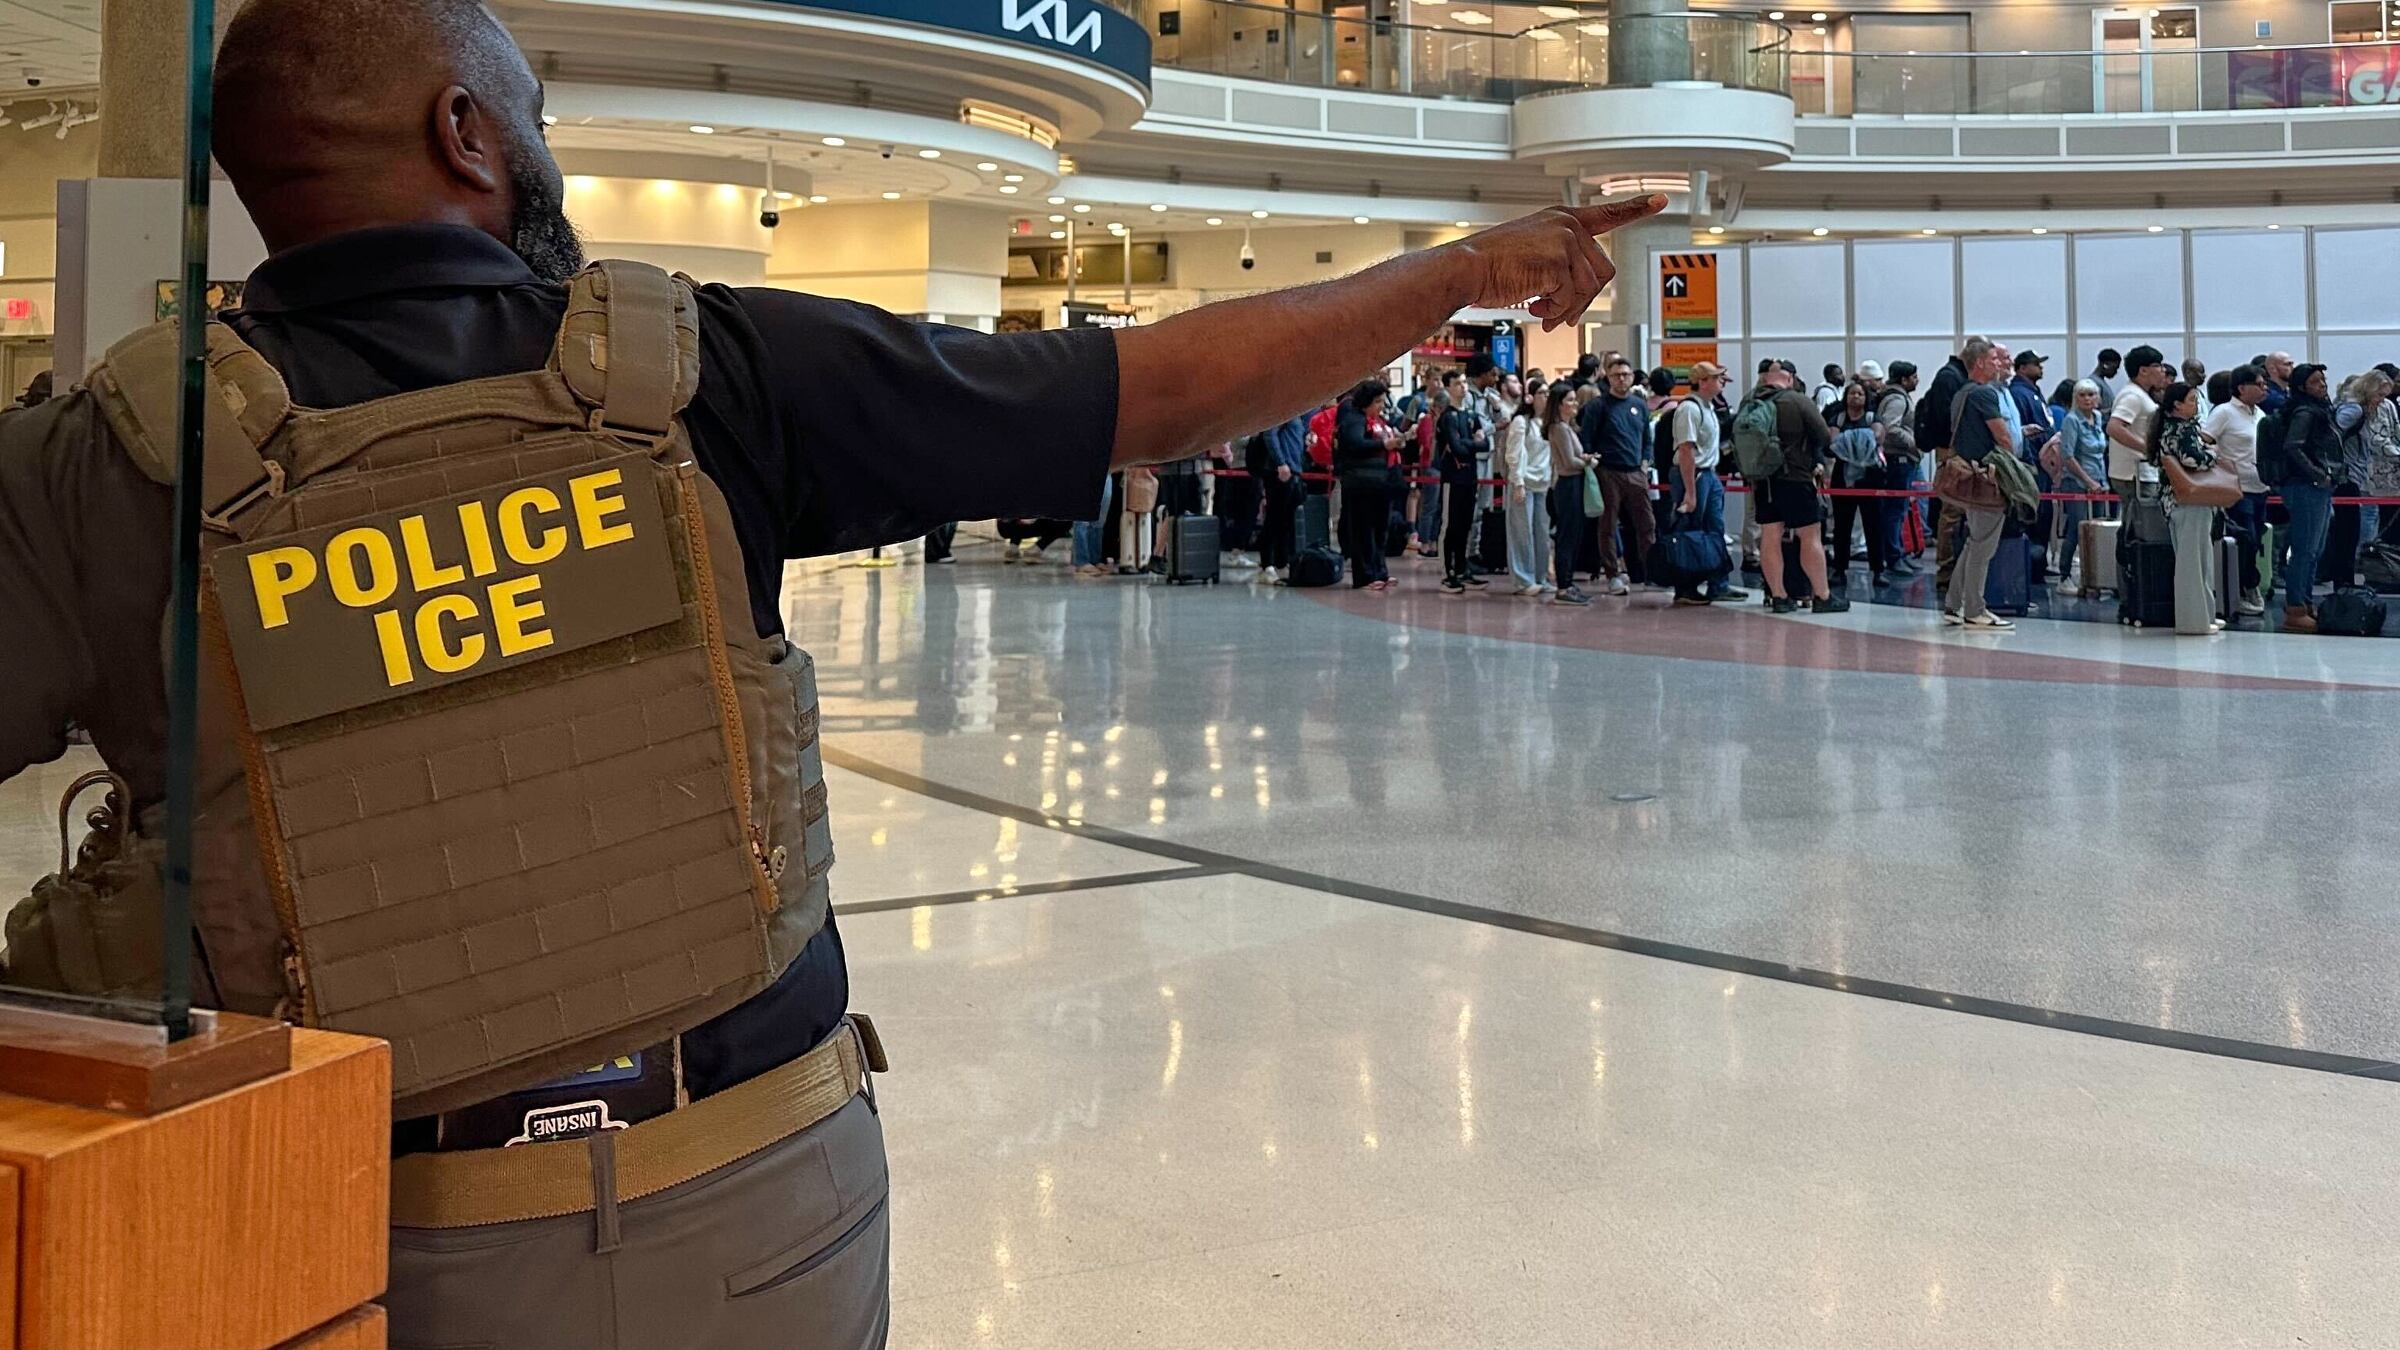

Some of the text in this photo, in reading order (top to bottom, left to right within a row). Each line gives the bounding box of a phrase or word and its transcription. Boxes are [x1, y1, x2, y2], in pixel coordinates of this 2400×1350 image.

[247, 468, 635, 629] POLICE
[374, 574, 554, 687] ICE
[533, 1111, 597, 1136] INSANE
